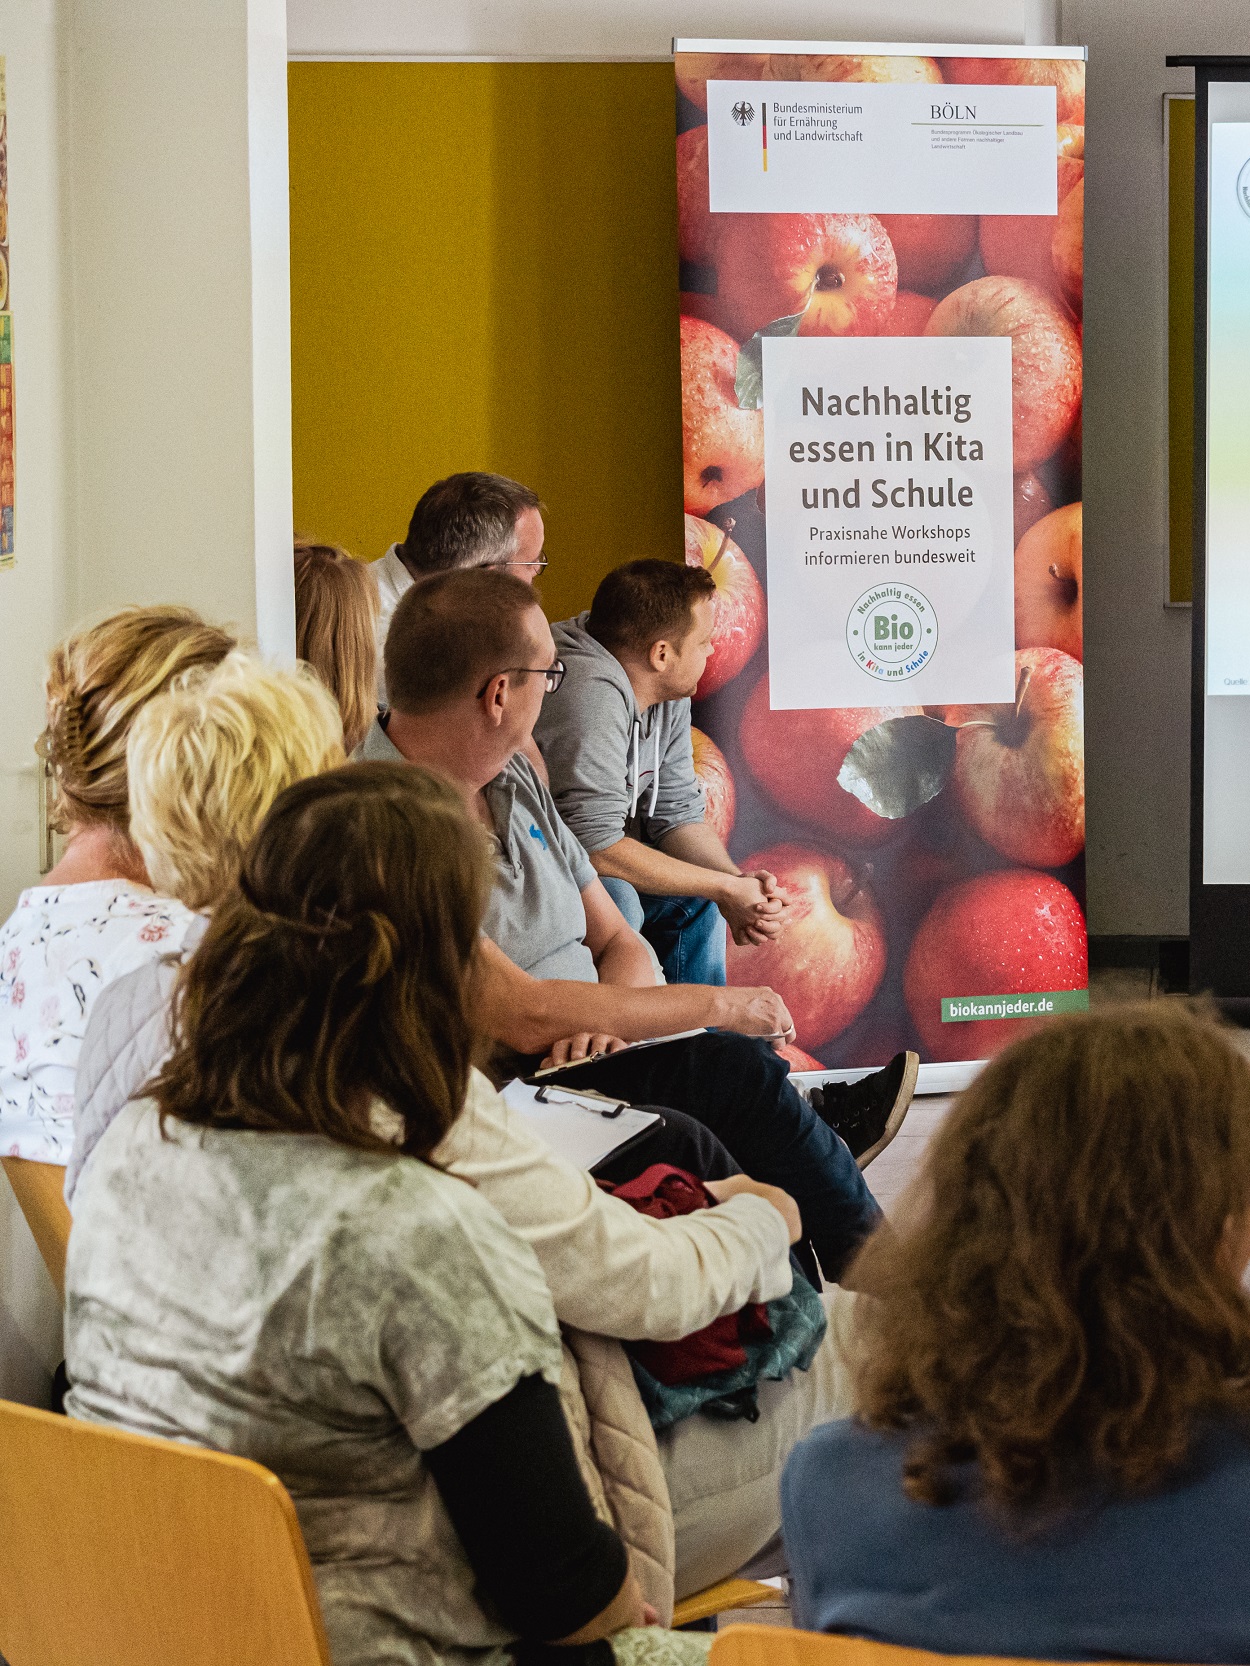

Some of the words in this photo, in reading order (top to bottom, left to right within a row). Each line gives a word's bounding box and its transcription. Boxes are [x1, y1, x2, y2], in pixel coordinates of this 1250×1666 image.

[773, 102, 863, 114] Bundesministerium
[930, 102, 977, 120] BÖLN
[773, 116, 787, 127] für
[789, 116, 838, 130] Ernährung
[773, 130, 792, 141] und
[794, 130, 863, 142] Landwirtschaft
[801, 385, 972, 423] Nachhaltig
[788, 439, 875, 463] essen
[886, 432, 913, 462] in
[924, 431, 984, 462] Kita
[801, 478, 860, 510] und
[871, 477, 974, 509] Schule
[809, 526, 888, 542] Praxisnahe
[891, 525, 971, 543] Workshops
[804, 551, 890, 566] informieren
[894, 549, 976, 565] bundesweit
[857, 587, 902, 615] Nachhaltig
[904, 593, 926, 613] essen
[873, 613, 914, 641] Bio
[873, 642, 893, 651] kann
[894, 642, 914, 652] jeder
[857, 650, 866, 662] in
[866, 659, 884, 675] Kita
[887, 666, 904, 677] und
[905, 650, 929, 673] Schule
[949, 997, 1054, 1018] biokannjeder.de
